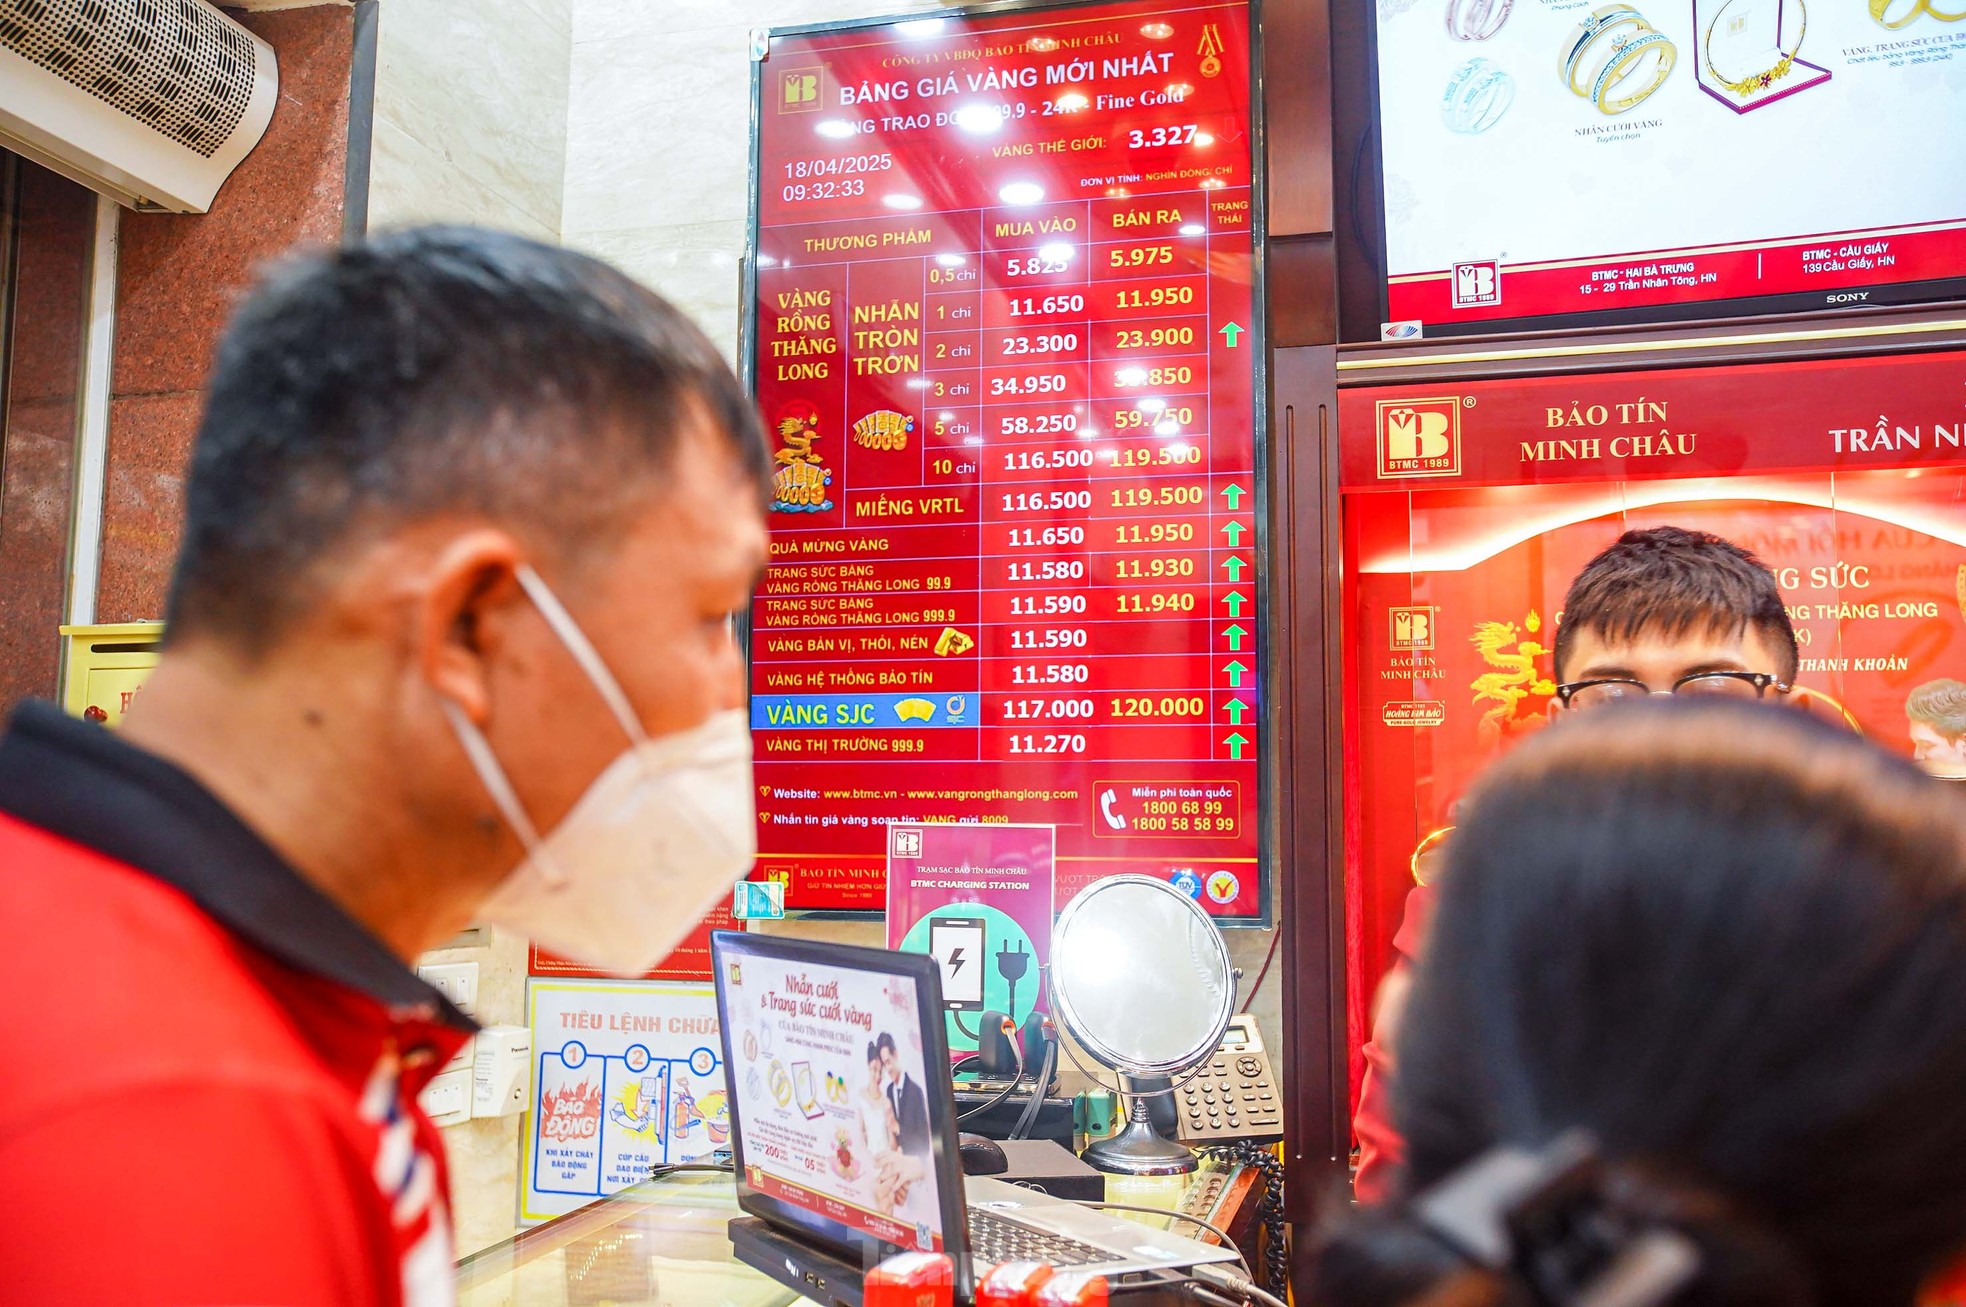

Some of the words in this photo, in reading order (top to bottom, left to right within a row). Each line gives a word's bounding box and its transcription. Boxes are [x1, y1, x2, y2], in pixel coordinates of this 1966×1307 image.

[840, 80, 909, 106] BẢNG
[917, 71, 959, 97] GIÁ
[966, 67, 1037, 92] VÀNG
[1045, 57, 1095, 84] MỚI
[1103, 51, 1174, 79] NHẤT
[1096, 93, 1135, 110] Fine
[1140, 88, 1184, 106] Gold
[881, 113, 931, 131] TRAO
[992, 142, 1034, 158] VÀNG
[1070, 136, 1108, 151] GIỚI:
[1128, 124, 1199, 149] 3.327
[785, 153, 892, 178] 18/04/2025
[783, 179, 865, 202] 09:32:33
[1211, 200, 1249, 213] TRẠNG
[995, 222, 1035, 238] MUA
[1039, 216, 1077, 233] VÀO
[1112, 208, 1151, 228] BÁN
[1156, 209, 1183, 224] RA
[1217, 213, 1243, 225] THÁI
[804, 233, 878, 253] THƯƠNG
[883, 227, 932, 246] PHẨM
[1110, 246, 1173, 267] 5.975
[1802, 247, 1831, 261] BTMC
[1839, 243, 1862, 258] CẦU
[1591, 269, 1619, 281] BTMC
[1625, 266, 1643, 278] HAI
[1643, 263, 1658, 276] BÀ
[1661, 262, 1694, 274] TRƯNG
[1802, 262, 1822, 274] 139
[1823, 257, 1845, 272] Cầu
[1877, 254, 1895, 267] HN
[930, 268, 954, 284] 0,5
[1579, 284, 1592, 295] 15
[1602, 282, 1616, 293] 29
[1642, 276, 1668, 289] Nhân
[1700, 272, 1717, 283] HN
[778, 287, 831, 309] VÀNG
[1009, 294, 1084, 316] 11.650
[1116, 286, 1193, 308] 11.950
[1826, 292, 1870, 304] SONY
[777, 307, 831, 333] RỒNG
[854, 299, 919, 325] NHẪN
[770, 336, 837, 358] THĂNG
[854, 324, 919, 350] TRÒN
[1003, 333, 1077, 355] 23.300
[1116, 327, 1193, 348] 23.900
[935, 343, 946, 359] 2
[777, 361, 829, 381] LONG
[853, 354, 919, 376] TRƠN
[934, 381, 945, 397] 3
[991, 374, 1066, 395] 34.950
[1114, 407, 1193, 429] 59.750
[1545, 400, 1608, 428] BẢO
[1616, 396, 1668, 425] TÍN
[934, 421, 945, 436] 5
[1001, 414, 1077, 435] 58.250
[1828, 414, 1920, 453] TRẦN
[1519, 437, 1602, 462] MINH
[1609, 428, 1697, 459] CHÂU
[932, 459, 952, 475] 10
[1004, 449, 1094, 470] 116.500
[1109, 446, 1201, 468] 119.500
[1388, 459, 1419, 470] BTMC
[1423, 457, 1450, 469] 1989
[856, 492, 913, 517] MIẾNG
[919, 498, 964, 515] VRTL
[1002, 490, 1092, 512] 116.500
[1111, 486, 1203, 507] 119.500
[1008, 526, 1084, 547] 11.650
[1115, 523, 1193, 543] 11.950
[802, 537, 845, 554] MỪNG
[849, 536, 889, 552] VÀNG
[768, 567, 808, 579] TRANG
[810, 564, 836, 579] SỨC
[1008, 561, 1084, 581] 11.580
[1115, 558, 1194, 578] 11.930
[1810, 561, 1870, 589] SỨC
[766, 579, 800, 595] VÀNG
[841, 576, 882, 592] THĂNG
[885, 579, 920, 591] LONG
[926, 576, 951, 591] 99.9
[766, 600, 807, 612] TRANG
[810, 597, 836, 611] SỨC
[1010, 595, 1087, 615] 11.590
[1116, 593, 1195, 614] 11.940
[1815, 601, 1880, 620] THĂNG
[1885, 602, 1938, 618] LONG
[766, 612, 800, 627] VÀNG
[840, 609, 882, 624] THĂNG
[885, 611, 920, 624] LONG
[922, 609, 955, 623] 999.9
[768, 636, 803, 653] VÀNG
[1011, 629, 1087, 648] 11.590
[1390, 654, 1413, 667] BẢO
[1417, 653, 1436, 667] TÍN
[1799, 657, 1848, 673] THANH
[1853, 652, 1908, 671] KHOẢN
[767, 670, 803, 687] VÀNG
[806, 669, 825, 688] HỆ
[829, 667, 875, 685] THỐNG
[878, 668, 907, 685] BẢO
[910, 667, 933, 684] TÍN
[1012, 664, 1088, 684] 11.580
[1380, 670, 1413, 680] MINH
[1413, 667, 1447, 680] CHÂU
[766, 699, 829, 725] VÀNG
[836, 703, 875, 725] SJC
[1003, 699, 1094, 719] 117.000
[1110, 697, 1204, 717] 120.000
[766, 736, 802, 752] VÀNG
[806, 738, 827, 754] THỊ
[832, 736, 888, 752] TRƯỜNG
[891, 739, 924, 753] 999.9
[1009, 734, 1086, 753] 11.270
[773, 788, 821, 799] Website:
[824, 789, 897, 799] www.btmc.vn
[907, 788, 1078, 802] www.vangrongthanglong.com
[1132, 785, 1158, 798] Miễn
[1160, 786, 1177, 800] phí
[1179, 786, 1204, 798] toàn
[1206, 785, 1233, 800] quốc
[1142, 801, 1177, 815] 1800
[1182, 801, 1200, 814] 68
[1204, 800, 1222, 814] 99
[773, 812, 802, 825] Nhắn
[805, 813, 819, 825] tin
[821, 813, 838, 828] giá
[841, 813, 868, 828] vàng
[1132, 817, 1167, 831] 1800
[1171, 817, 1189, 831] 58
[1193, 817, 1211, 831] 58
[1216, 817, 1234, 831] 99
[910, 880, 936, 888] BTMC
[938, 880, 988, 889] CHARGING
[989, 882, 1030, 890] STATION
[785, 973, 814, 996] Nhẫn
[769, 991, 797, 1018] Trang
[844, 1008, 873, 1031] vàng
[560, 1009, 603, 1030] TIÊU
[609, 1011, 661, 1035] LỆNH
[632, 1049, 644, 1066] 2
[697, 1052, 709, 1069] 3
[546, 1115, 596, 1138] ĐỘNG
[765, 1144, 780, 1160] 200
